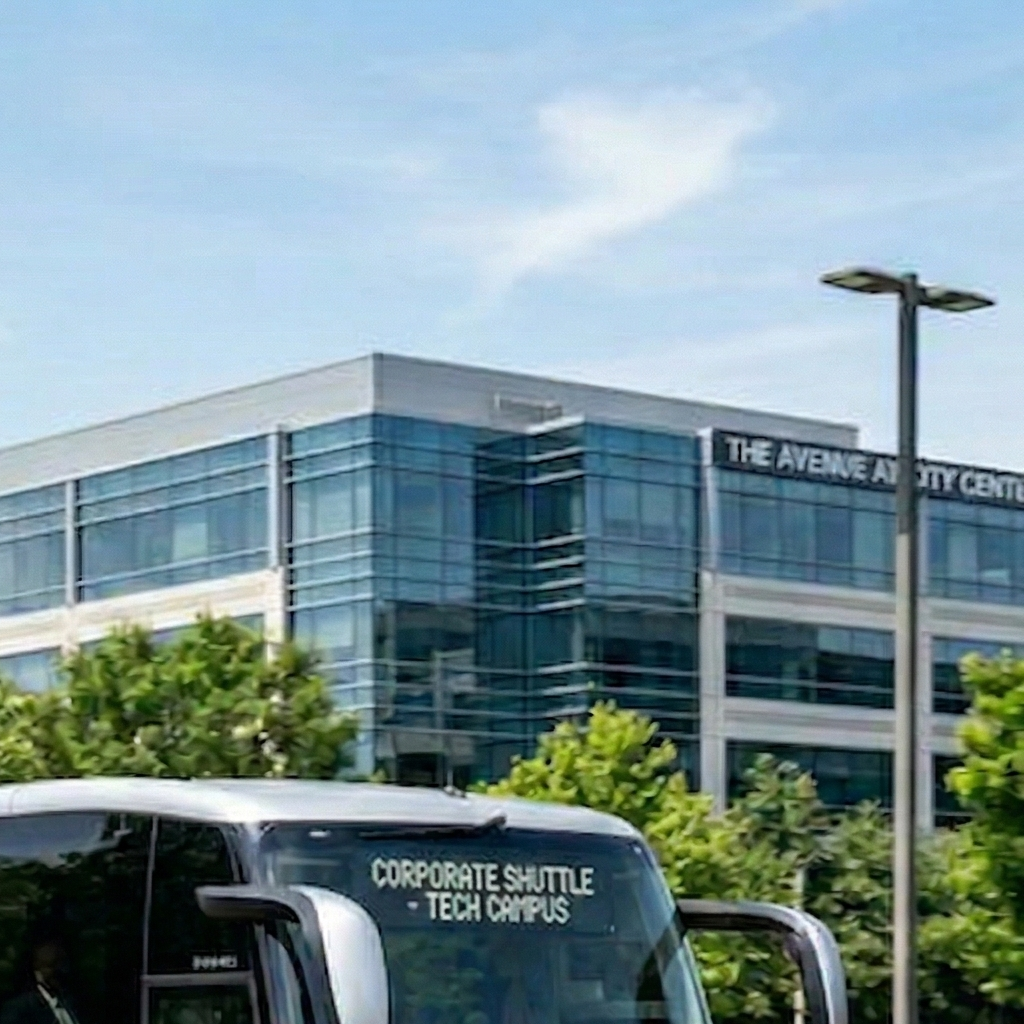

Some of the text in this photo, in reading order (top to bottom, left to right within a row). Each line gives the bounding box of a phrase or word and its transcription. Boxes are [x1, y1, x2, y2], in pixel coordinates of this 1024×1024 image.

[725, 436, 773, 467] THE
[916, 460, 958, 492] ITY
[371, 857, 595, 896] CORPORATE SHUTTLE
[426, 890, 481, 922] TECH
[486, 894, 571, 925] CAMPUS
